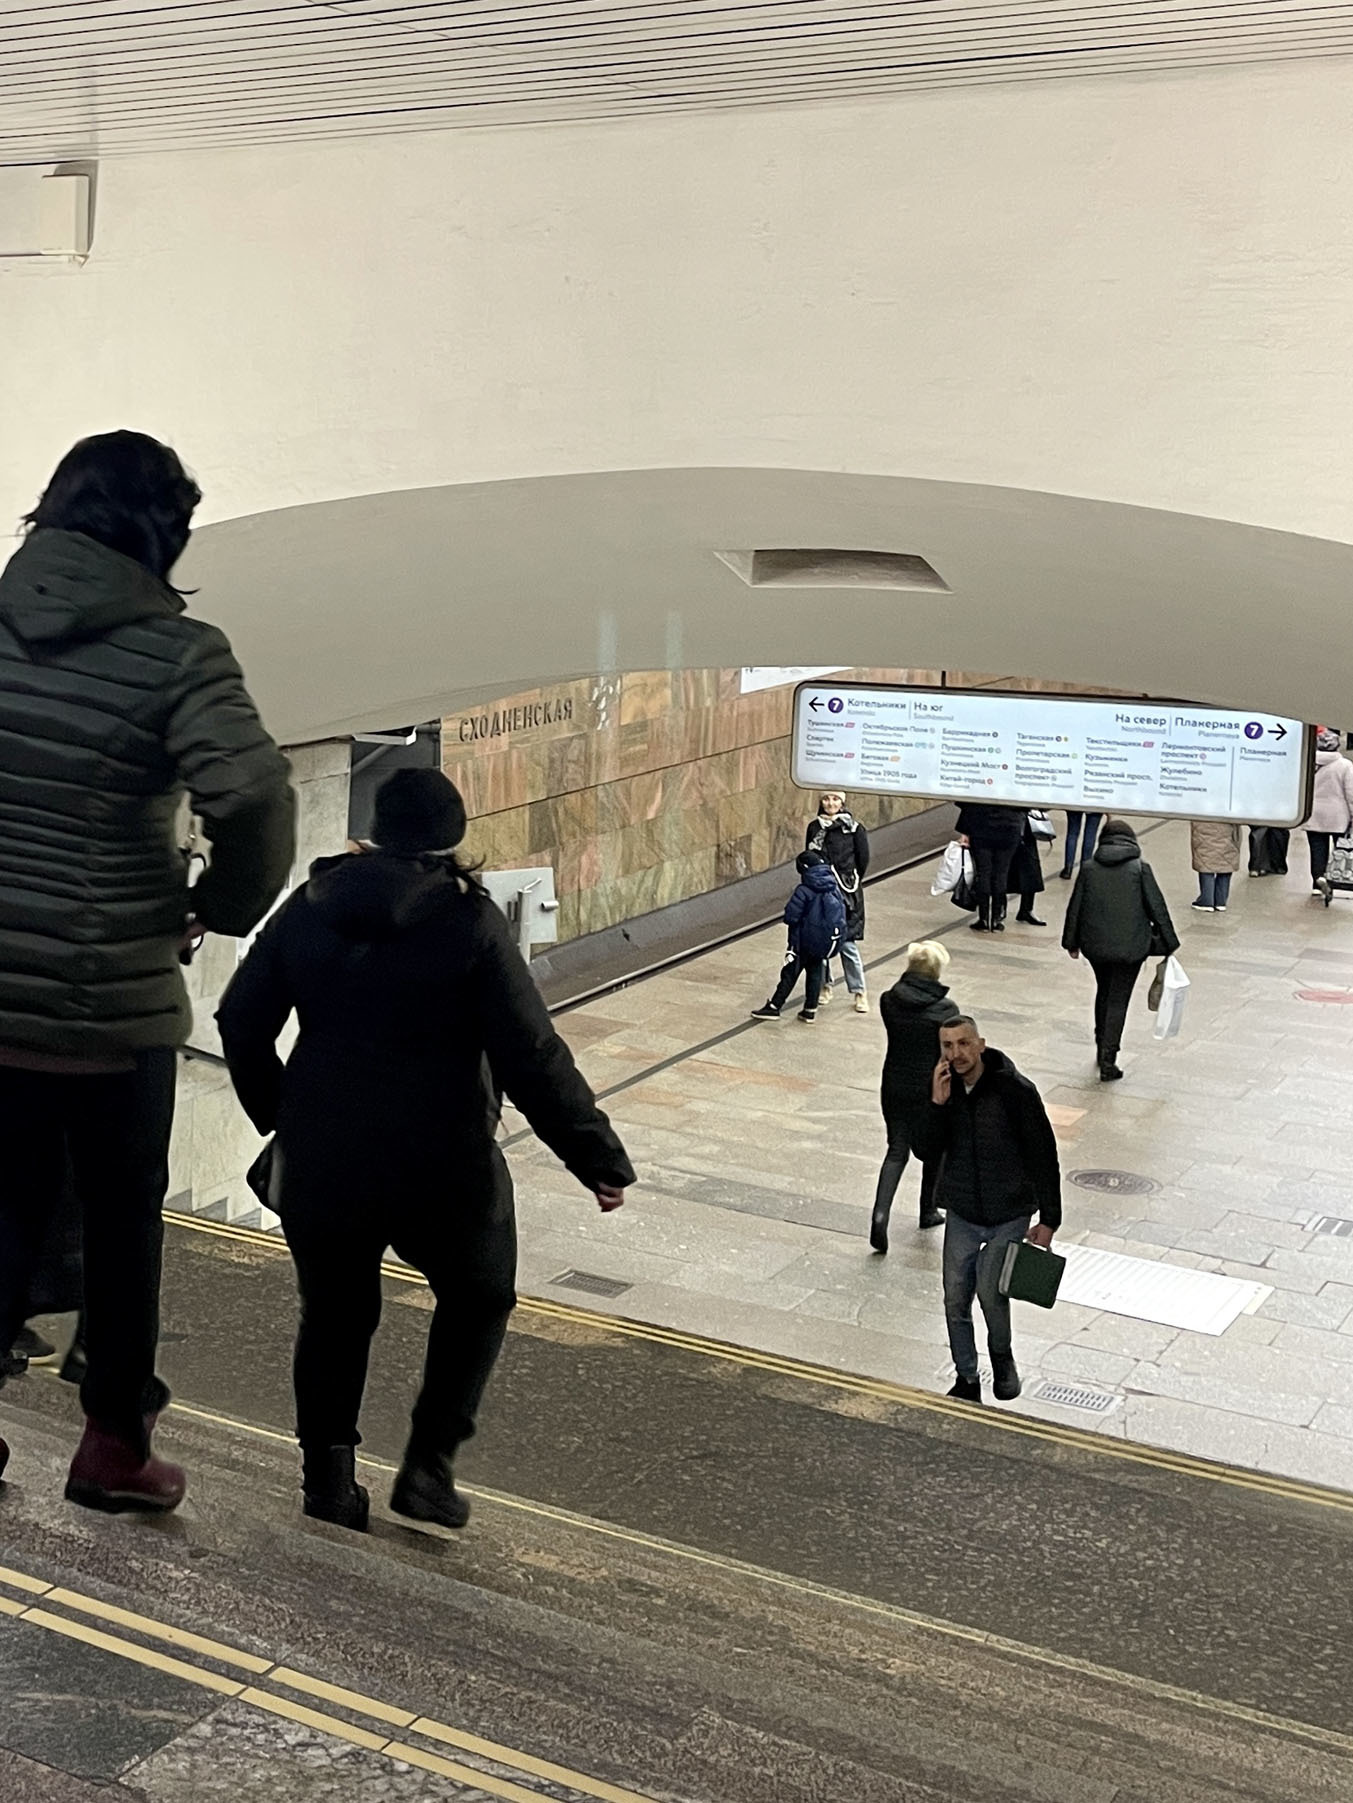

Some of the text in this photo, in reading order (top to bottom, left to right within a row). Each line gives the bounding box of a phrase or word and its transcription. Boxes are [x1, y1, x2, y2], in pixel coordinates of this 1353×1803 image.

[848, 698, 907, 710] Котельники
[914, 702, 943, 712] На юг
[458, 698, 574, 742] СХОДНЕНСКАЯ
[1115, 713, 1167, 727] На север
[1175, 717, 1240, 730] Планерная
